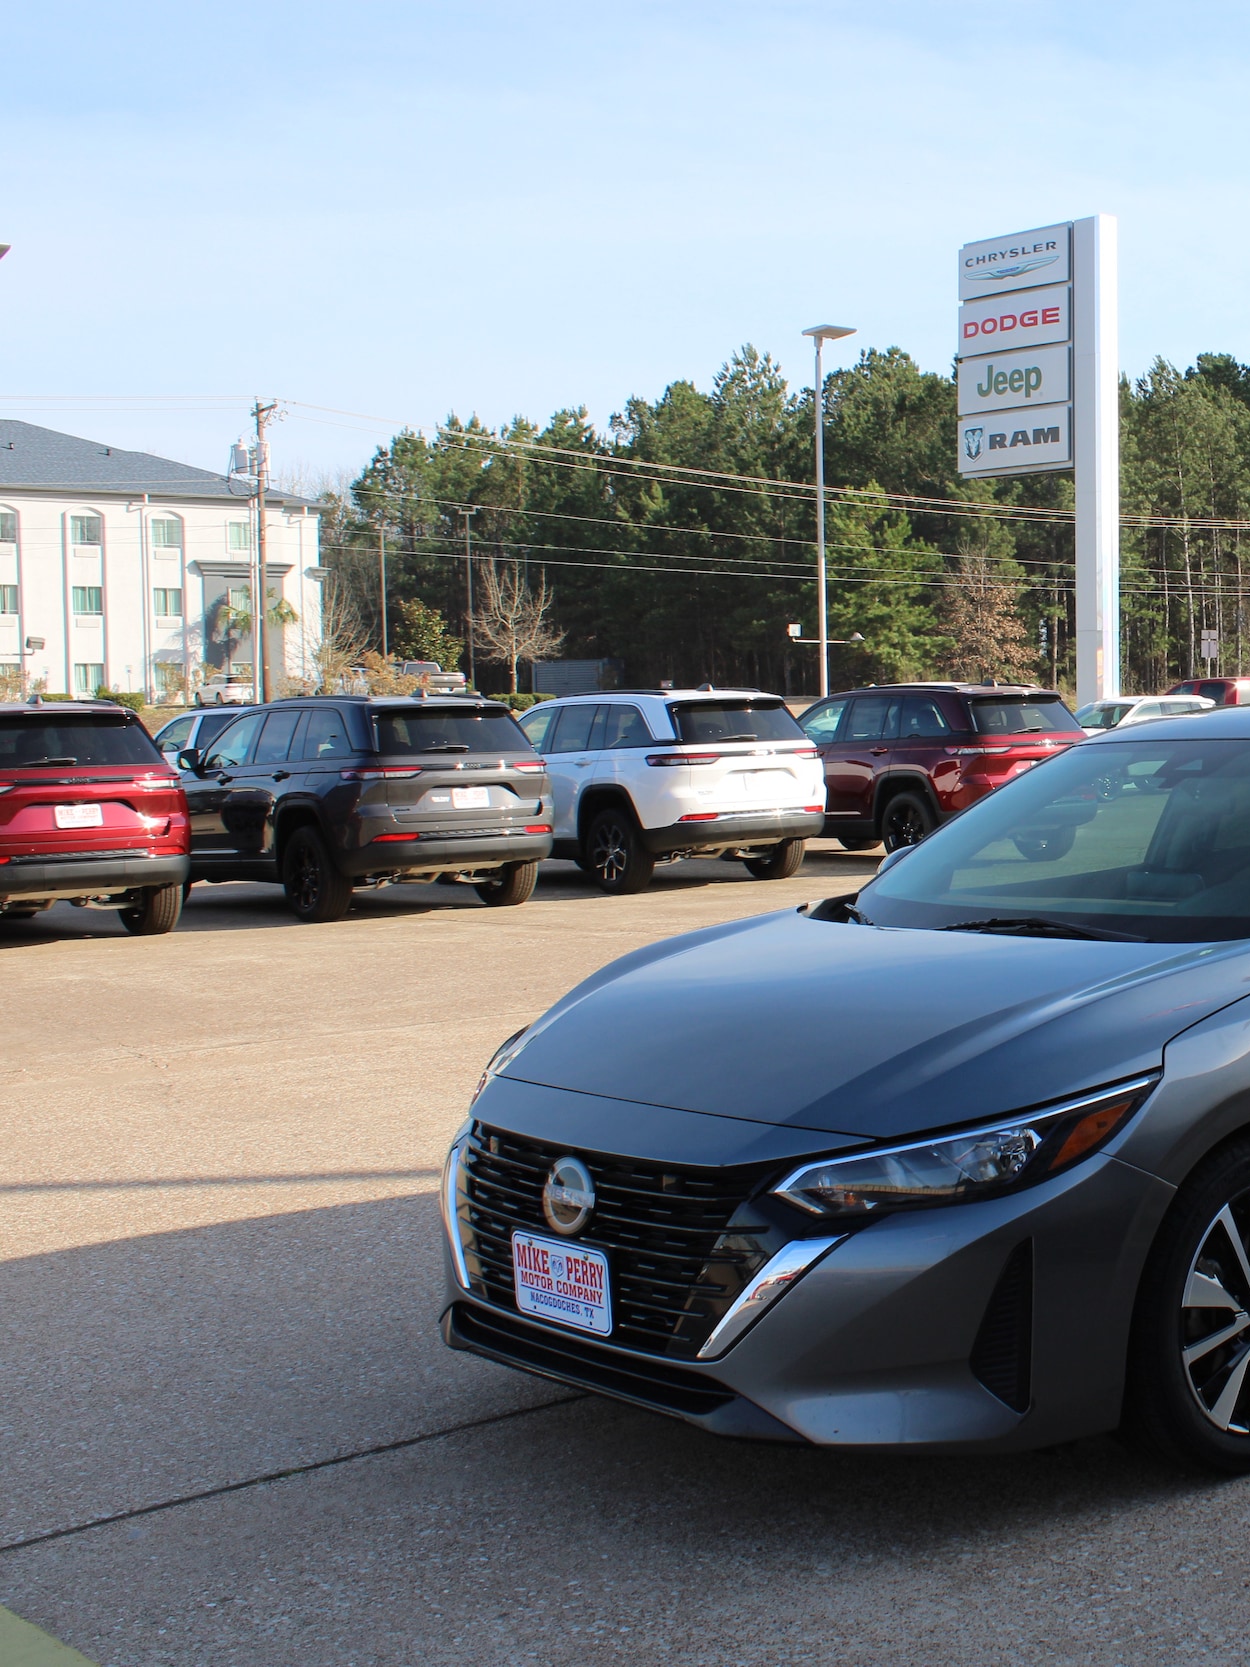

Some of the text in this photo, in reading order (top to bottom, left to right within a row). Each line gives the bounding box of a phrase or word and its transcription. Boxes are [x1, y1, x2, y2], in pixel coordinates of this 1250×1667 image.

[965, 241, 1057, 268] CHRYSLER
[963, 306, 1060, 338] DODGE
[977, 364, 1042, 398] Jeep
[989, 426, 1060, 450] RAM
[516, 1243, 604, 1290] MIKE PERRY
[521, 1270, 603, 1304] MOTOR COMPANY
[584, 1307, 595, 1319] TX
